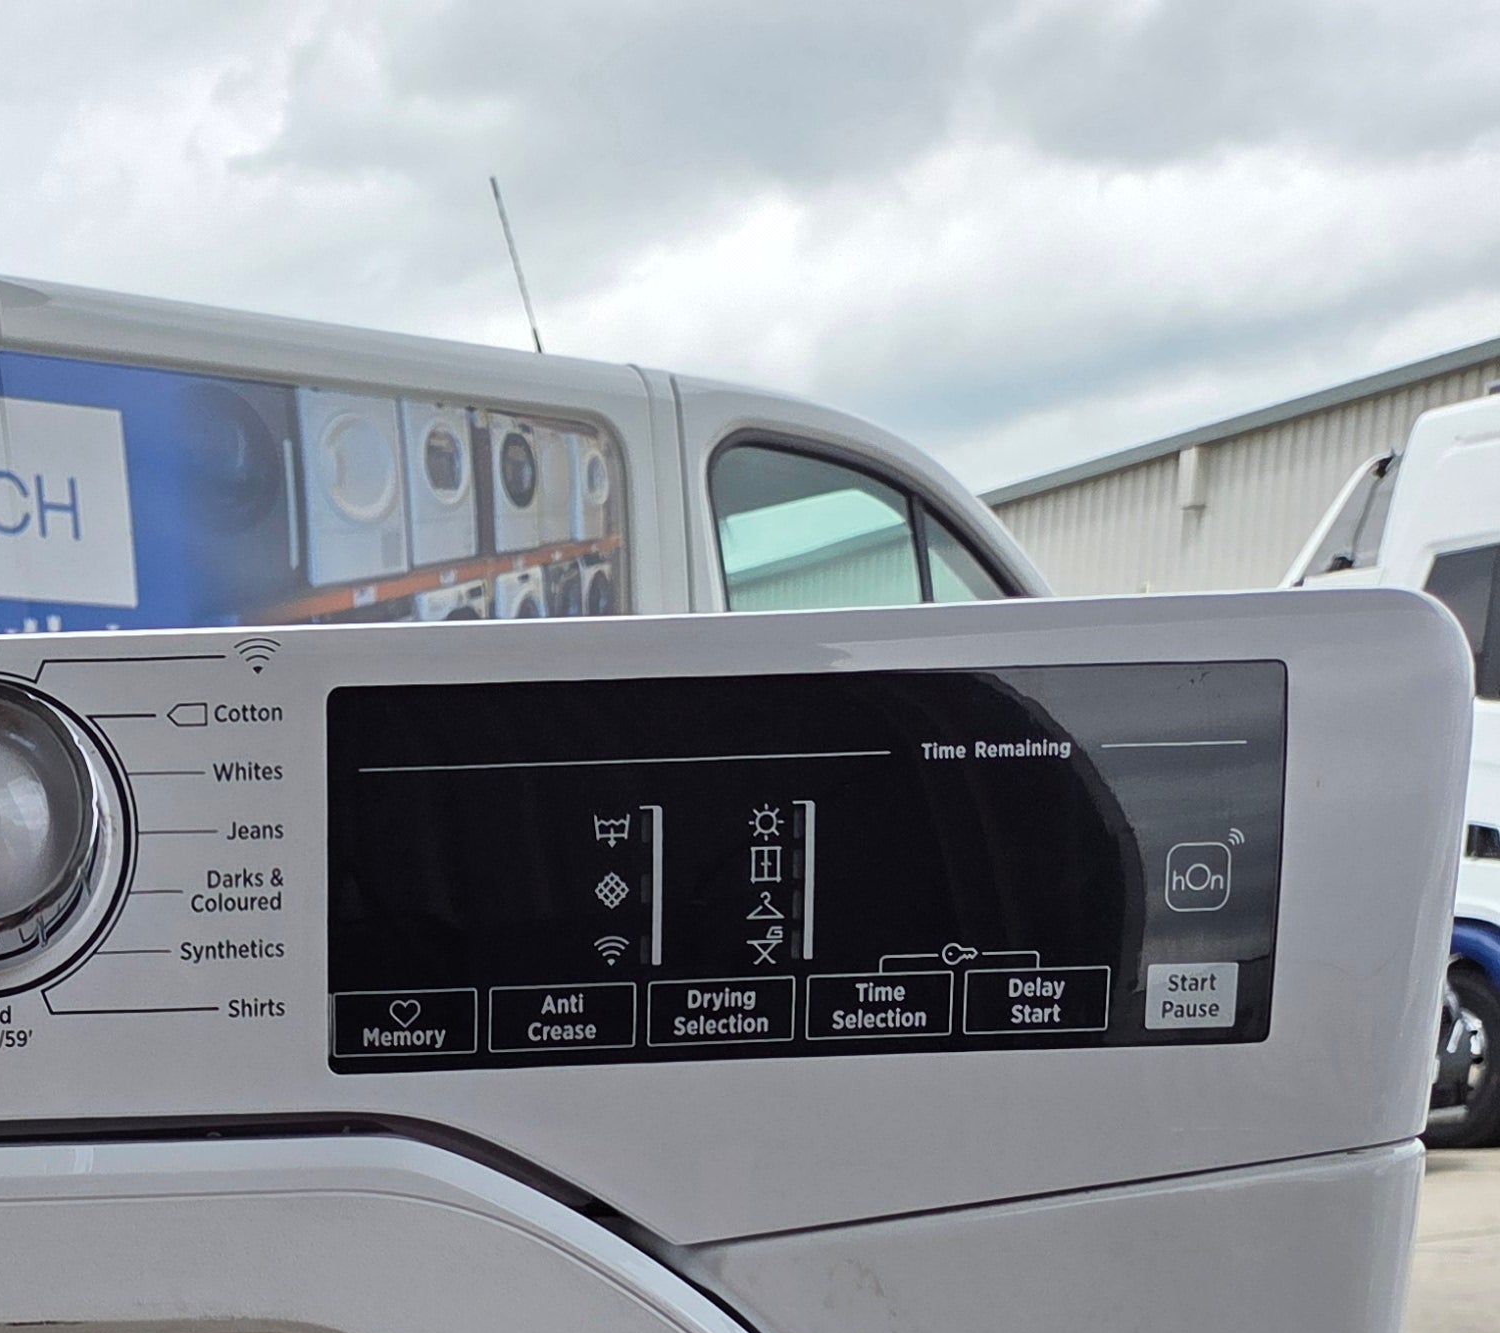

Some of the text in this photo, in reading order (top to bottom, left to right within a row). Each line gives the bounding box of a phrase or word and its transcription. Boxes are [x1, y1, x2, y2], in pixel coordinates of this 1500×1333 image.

[213, 705, 283, 724] Cotton
[921, 739, 1072, 760] Time Remaining
[213, 764, 283, 782] Whites
[226, 822, 284, 840] Jeans
[207, 868, 284, 889] Darks &
[1172, 864, 1224, 891] hOn
[191, 892, 282, 912] Coloured
[180, 940, 285, 964] Synthetics
[855, 982, 906, 1002] Time
[1009, 979, 1066, 1000] Delay
[1168, 974, 1216, 993] Start
[228, 998, 286, 1018] Shirts
[541, 994, 584, 1014] Anti
[687, 988, 757, 1010] Drying
[832, 1008, 927, 1030] Selection
[1011, 1003, 1061, 1024] Start
[1161, 1001, 1220, 1020] Pause
[527, 1022, 597, 1042] Crease
[673, 1015, 769, 1036] Selection
[363, 1026, 446, 1050] Memory
